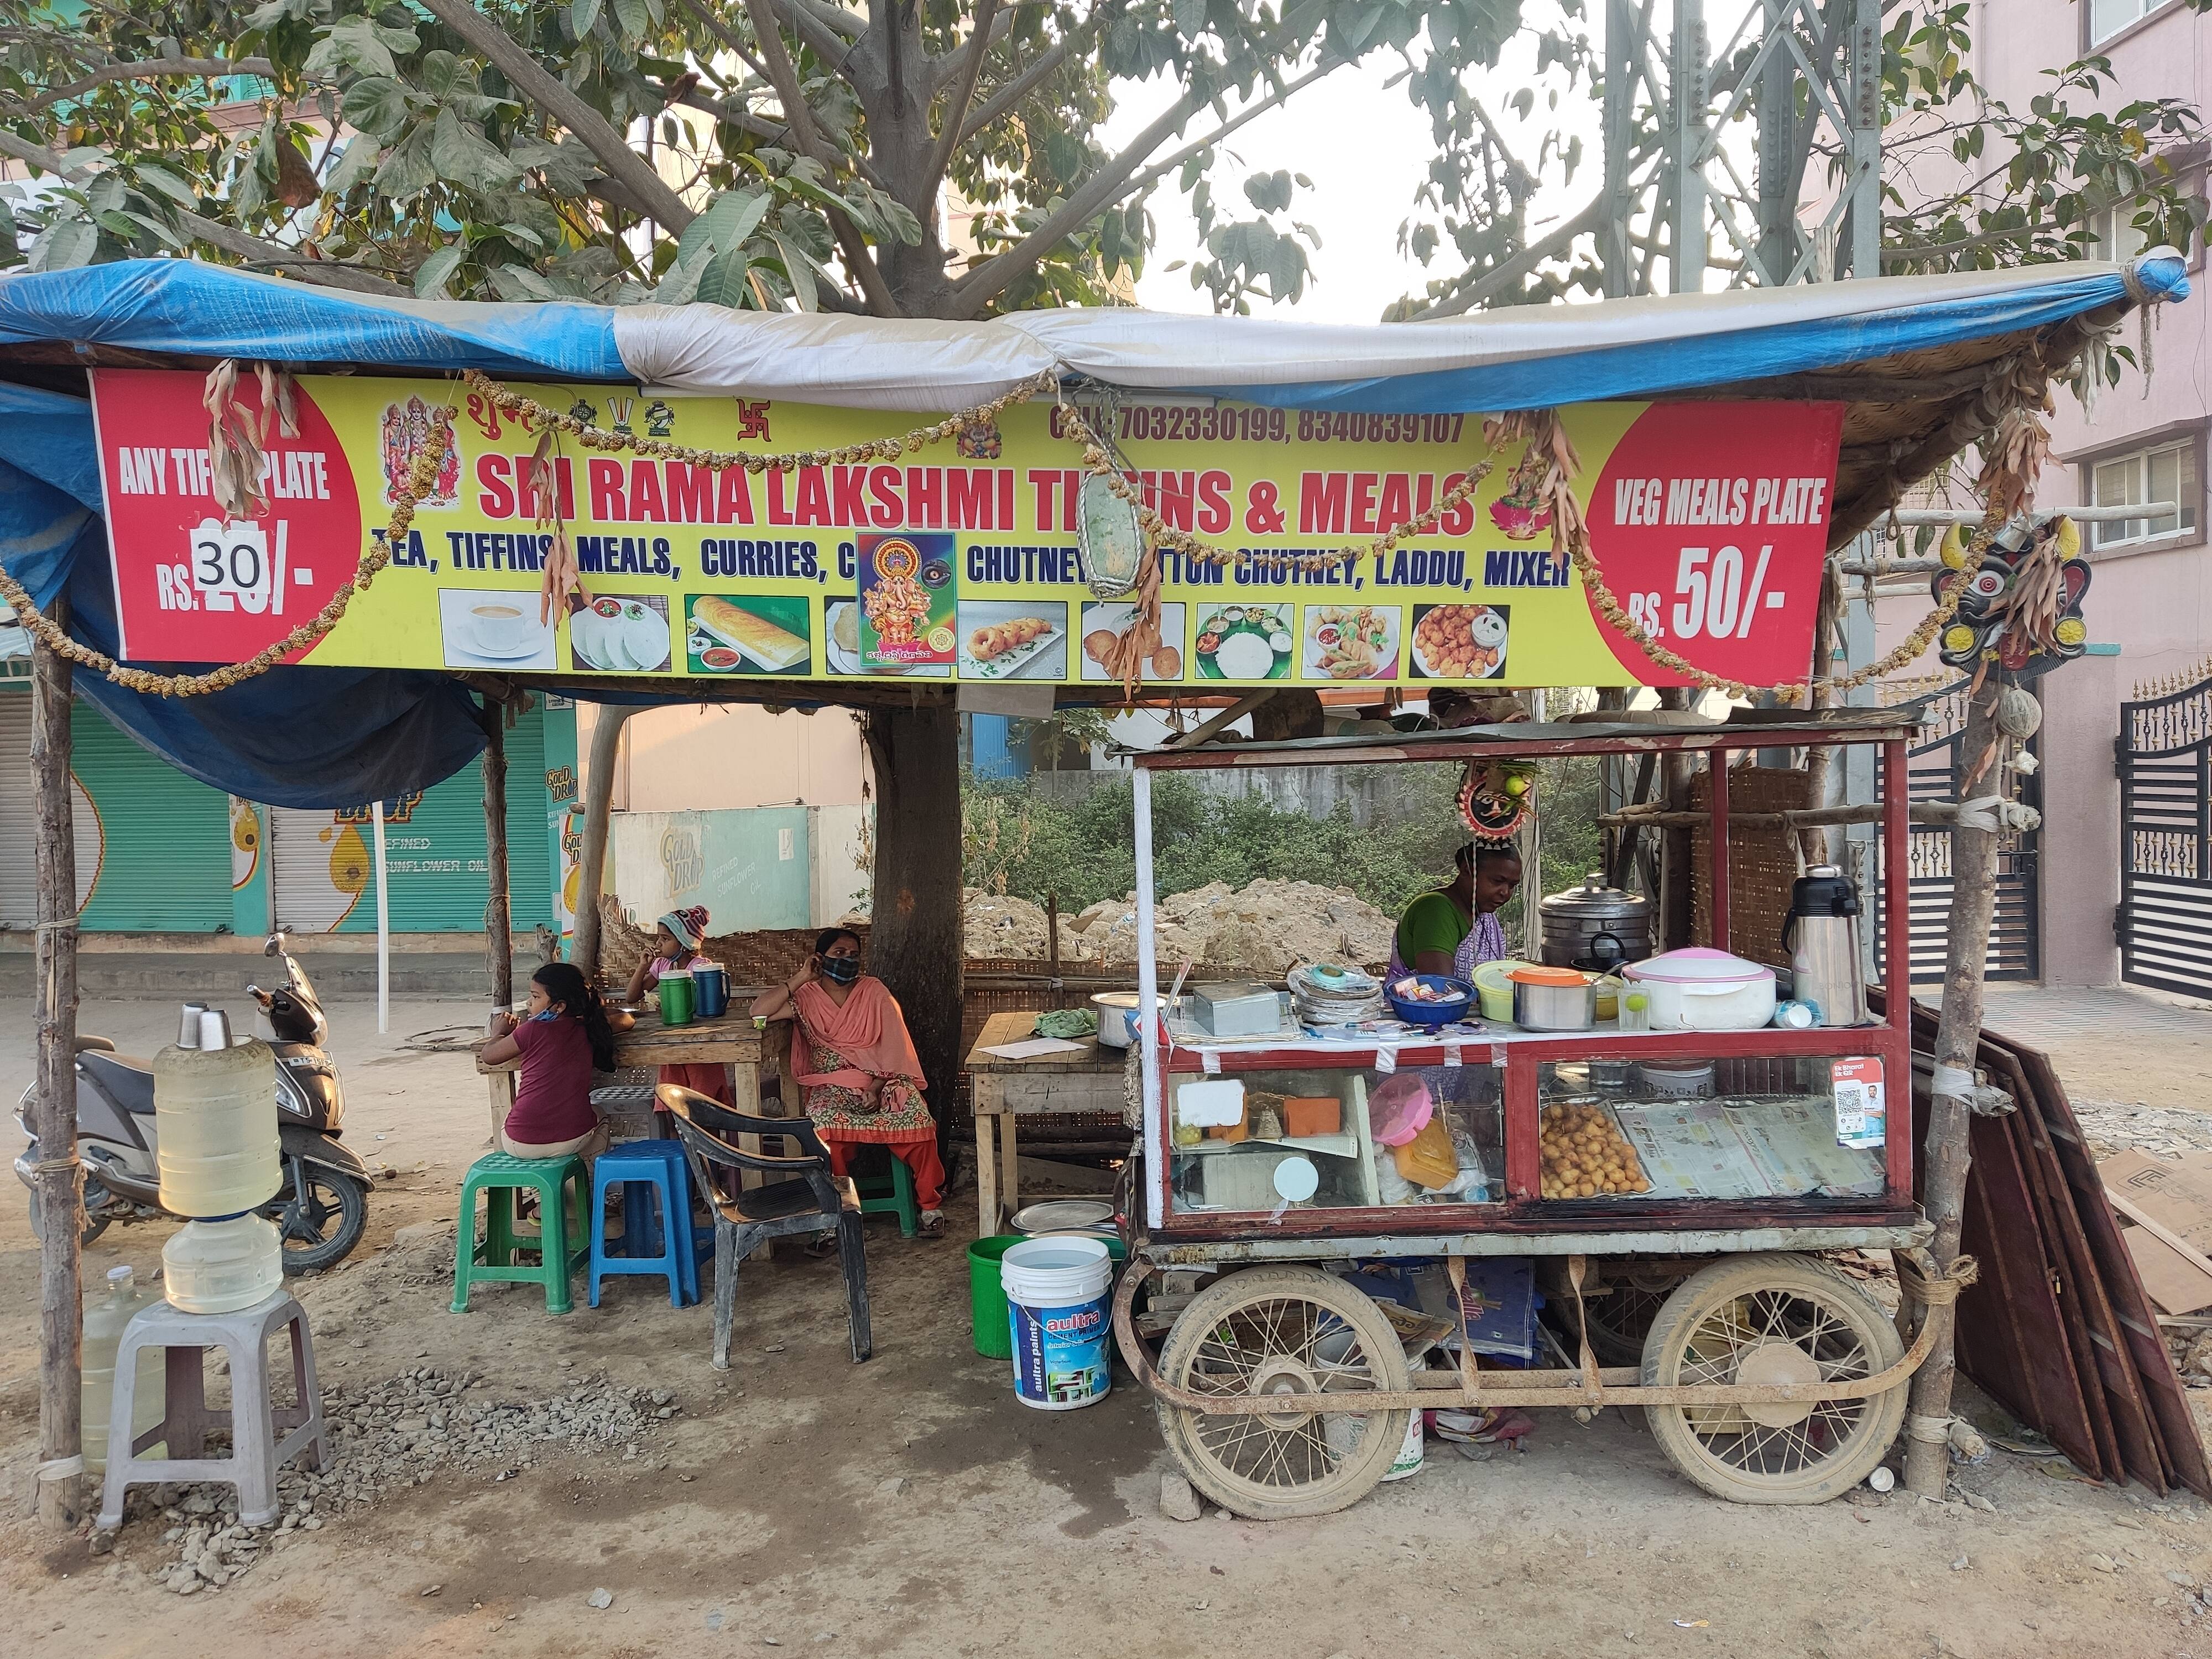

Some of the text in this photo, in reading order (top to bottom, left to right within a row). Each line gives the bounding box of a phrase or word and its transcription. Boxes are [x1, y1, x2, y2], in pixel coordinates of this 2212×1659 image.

[1297, 408, 1463, 443] 8340839107
[119, 447, 166, 495] ANY
[263, 451, 331, 500] PLATE
[477, 455, 1477, 536] SRI RAMA LAKSHMI TIINS & MEALS
[1615, 477, 1827, 526] VEG MEALS PLATE
[576, 535, 682, 582] MEALS,
[701, 539, 827, 585] CURRIES,
[1234, 548, 1366, 592] CHUTNEY,
[1375, 549, 1474, 592] LADDU,
[1484, 550, 1571, 588] MIXER
[156, 564, 200, 612] RS.
[1627, 545, 1786, 639] RS. 50/-
[545, 765, 571, 787] GOLD
[553, 778, 578, 803] DROP
[385, 838, 431, 850] EFINED
[562, 832, 581, 854] GOL
[664, 832, 694, 872] GOLD
[468, 860, 488, 872] OIL
[674, 848, 704, 891] DROP
[712, 857, 738, 883] REFINED
[717, 862, 756, 898] SUNFLOWER
[750, 879, 761, 895] OIL
[1047, 1311, 1100, 1332] aultra
[1079, 1325, 1100, 1337] PRIMER
[1030, 1319, 1042, 1392] aultra paints
